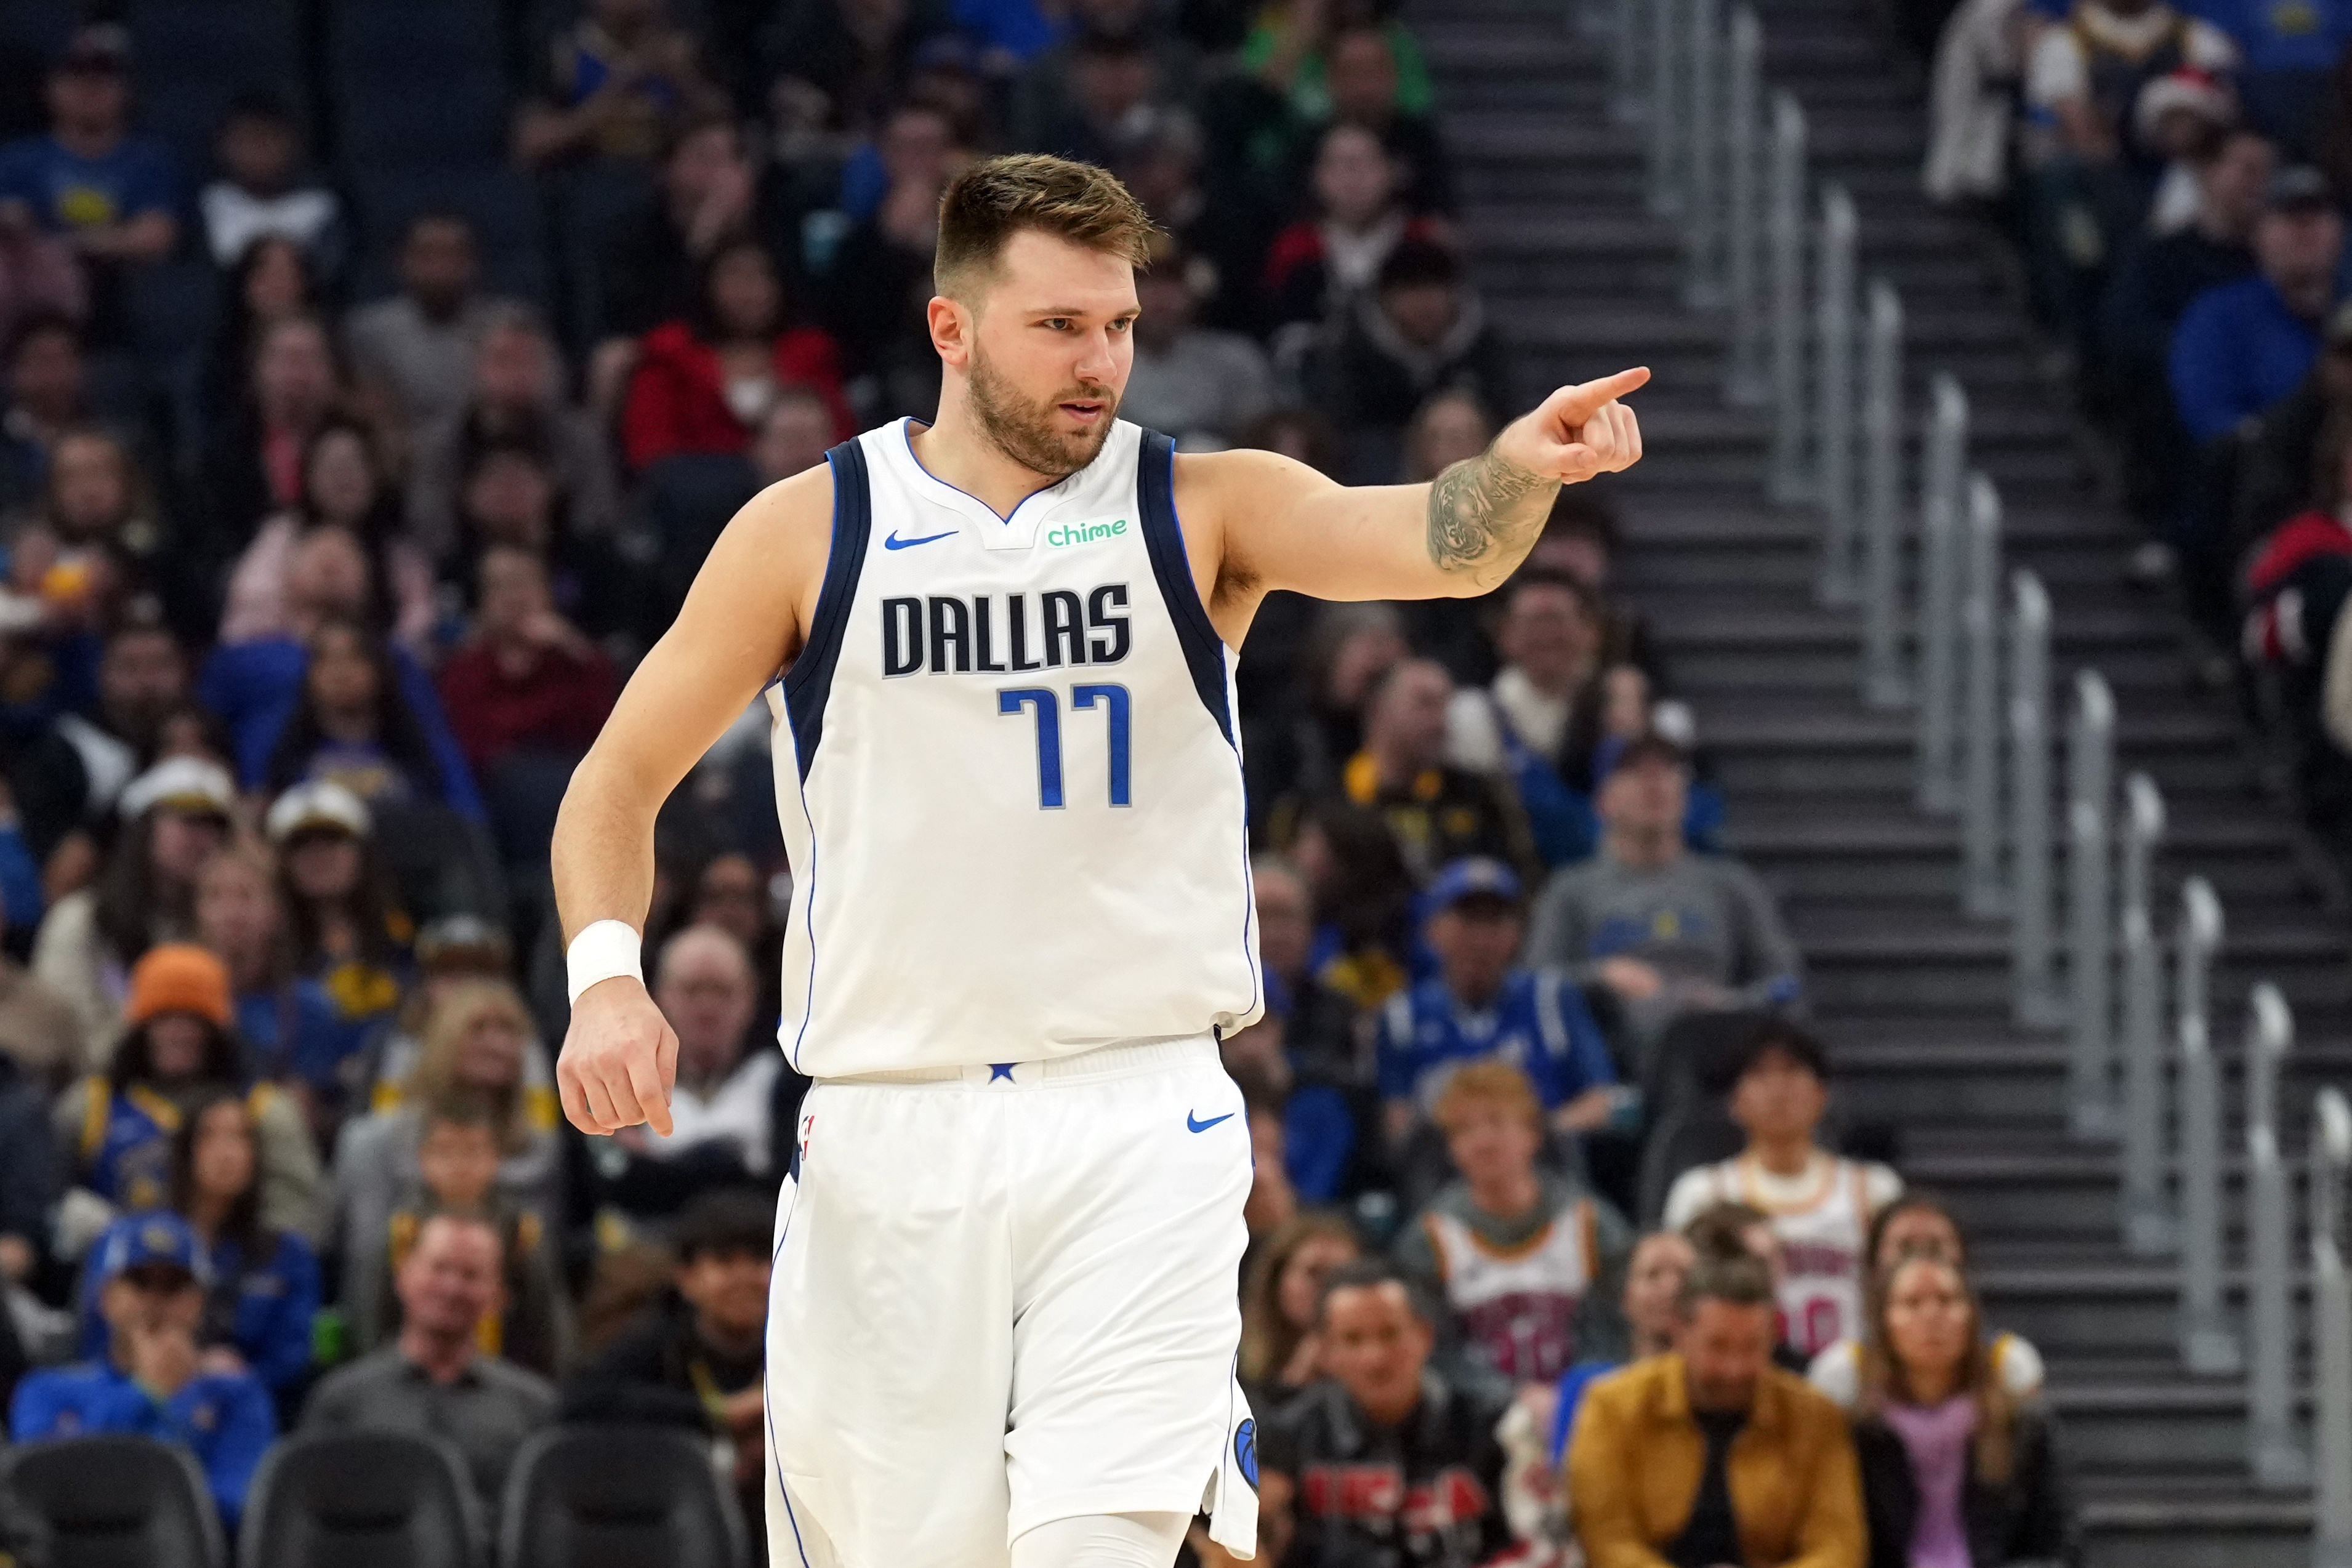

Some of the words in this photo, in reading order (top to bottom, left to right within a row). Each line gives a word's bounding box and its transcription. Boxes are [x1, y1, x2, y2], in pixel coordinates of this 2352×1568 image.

[1048, 520, 1127, 546] chime
[880, 582, 1132, 679] DALLAS
[997, 683, 1132, 810] 77
